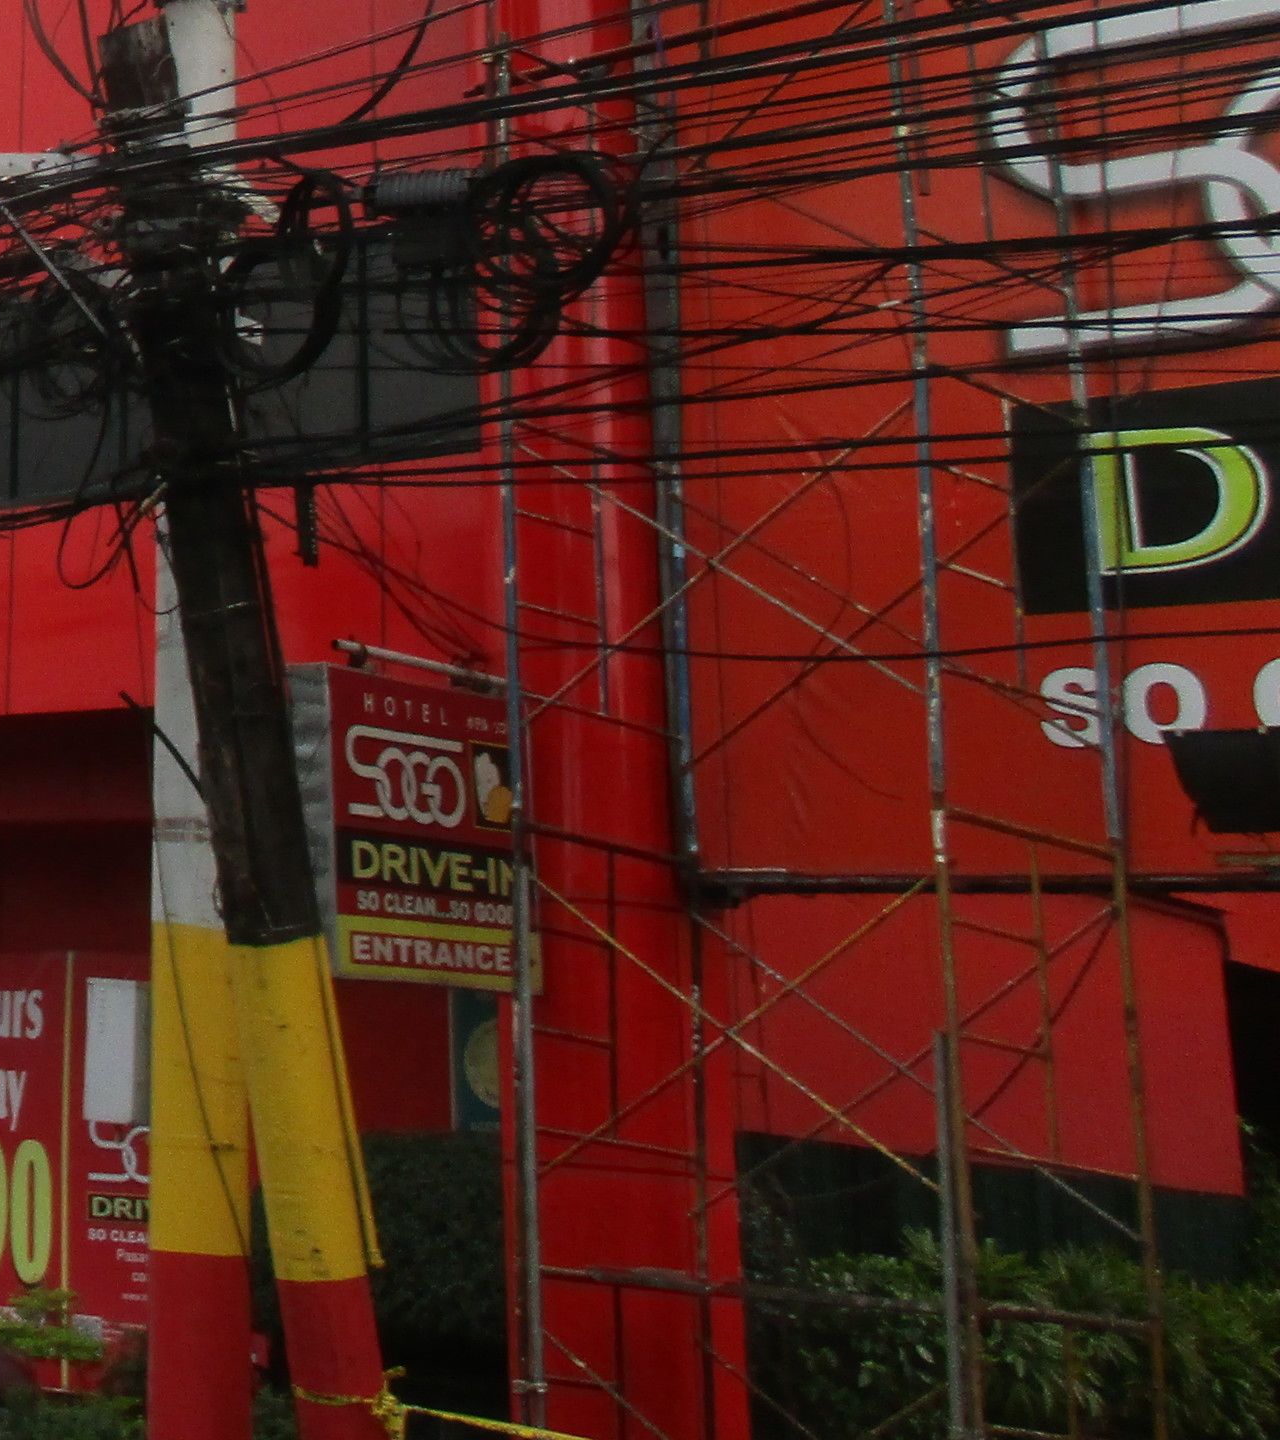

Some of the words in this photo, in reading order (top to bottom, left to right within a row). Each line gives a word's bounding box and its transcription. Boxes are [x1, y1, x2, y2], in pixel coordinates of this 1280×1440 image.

[363, 692, 449, 726] HOTEL
[345, 724, 466, 828] SOGO
[352, 839, 513, 897] DRIVE-IN
[356, 889, 380, 911] SO
[353, 934, 512, 972] ENTRANCE
[91, 1195, 150, 1221] DRI
[88, 1227, 107, 1241] SO
